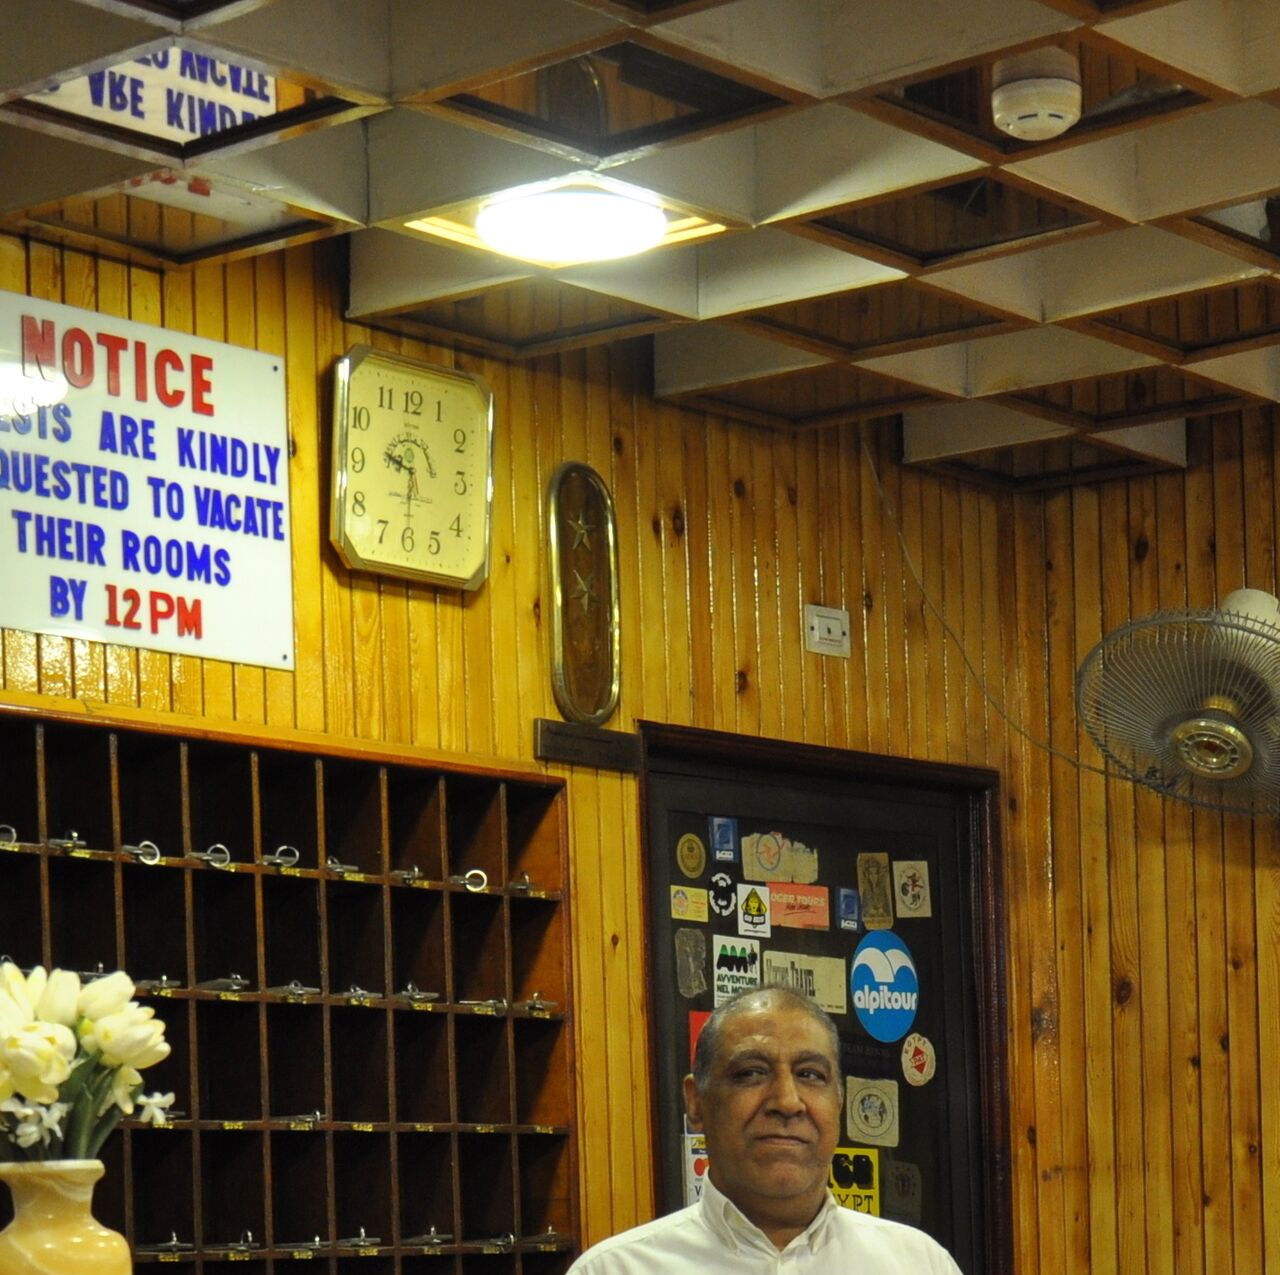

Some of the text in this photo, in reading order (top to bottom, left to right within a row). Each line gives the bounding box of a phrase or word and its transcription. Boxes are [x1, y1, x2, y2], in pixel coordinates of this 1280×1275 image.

[20, 313, 215, 418] NOTICE
[377, 386, 395, 411] 11
[403, 390, 424, 416] 12
[434, 399, 443, 423] 1
[351, 405, 371, 432] 10
[99, 409, 158, 462] ARE
[176, 426, 282, 487] KINDLY
[453, 428, 467, 454] 2
[350, 447, 366, 474] 9
[454, 471, 467, 496] 3
[146, 475, 185, 522] TO
[193, 484, 286, 542] VACATE
[351, 490, 367, 518] 8
[376, 519, 390, 545] 7
[449, 513, 464, 538] 4
[11, 508, 232, 588] THEIR ROOMS
[401, 526, 415, 553] 6
[427, 530, 441, 556] 5
[49, 574, 88, 622] BY
[853, 983, 918, 1015] alpitour
